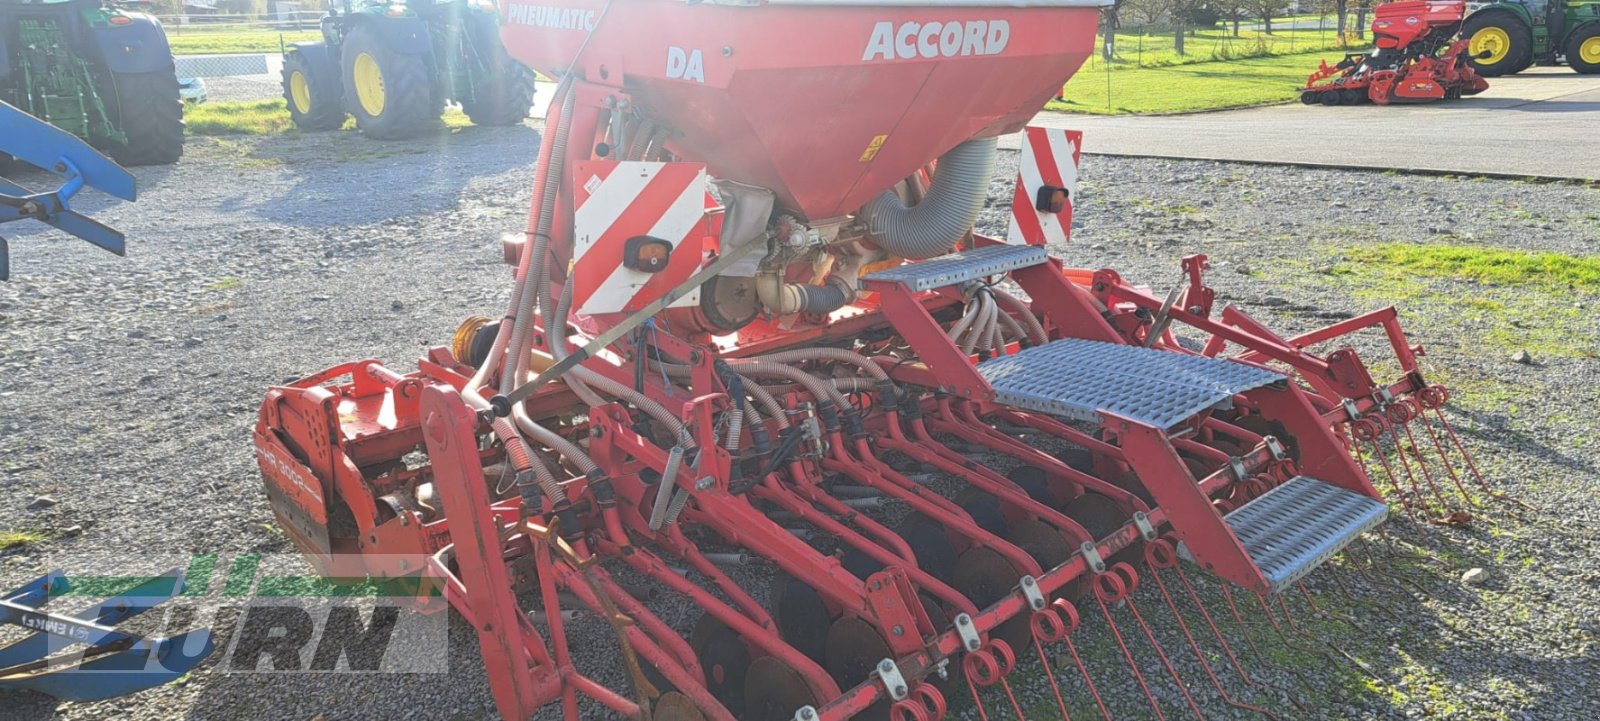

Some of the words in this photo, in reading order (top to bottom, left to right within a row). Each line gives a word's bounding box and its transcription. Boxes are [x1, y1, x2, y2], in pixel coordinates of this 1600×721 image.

[507, 3, 595, 32] PNEUMATIC
[861, 19, 1010, 61] ACCORD
[666, 46, 705, 83] DA
